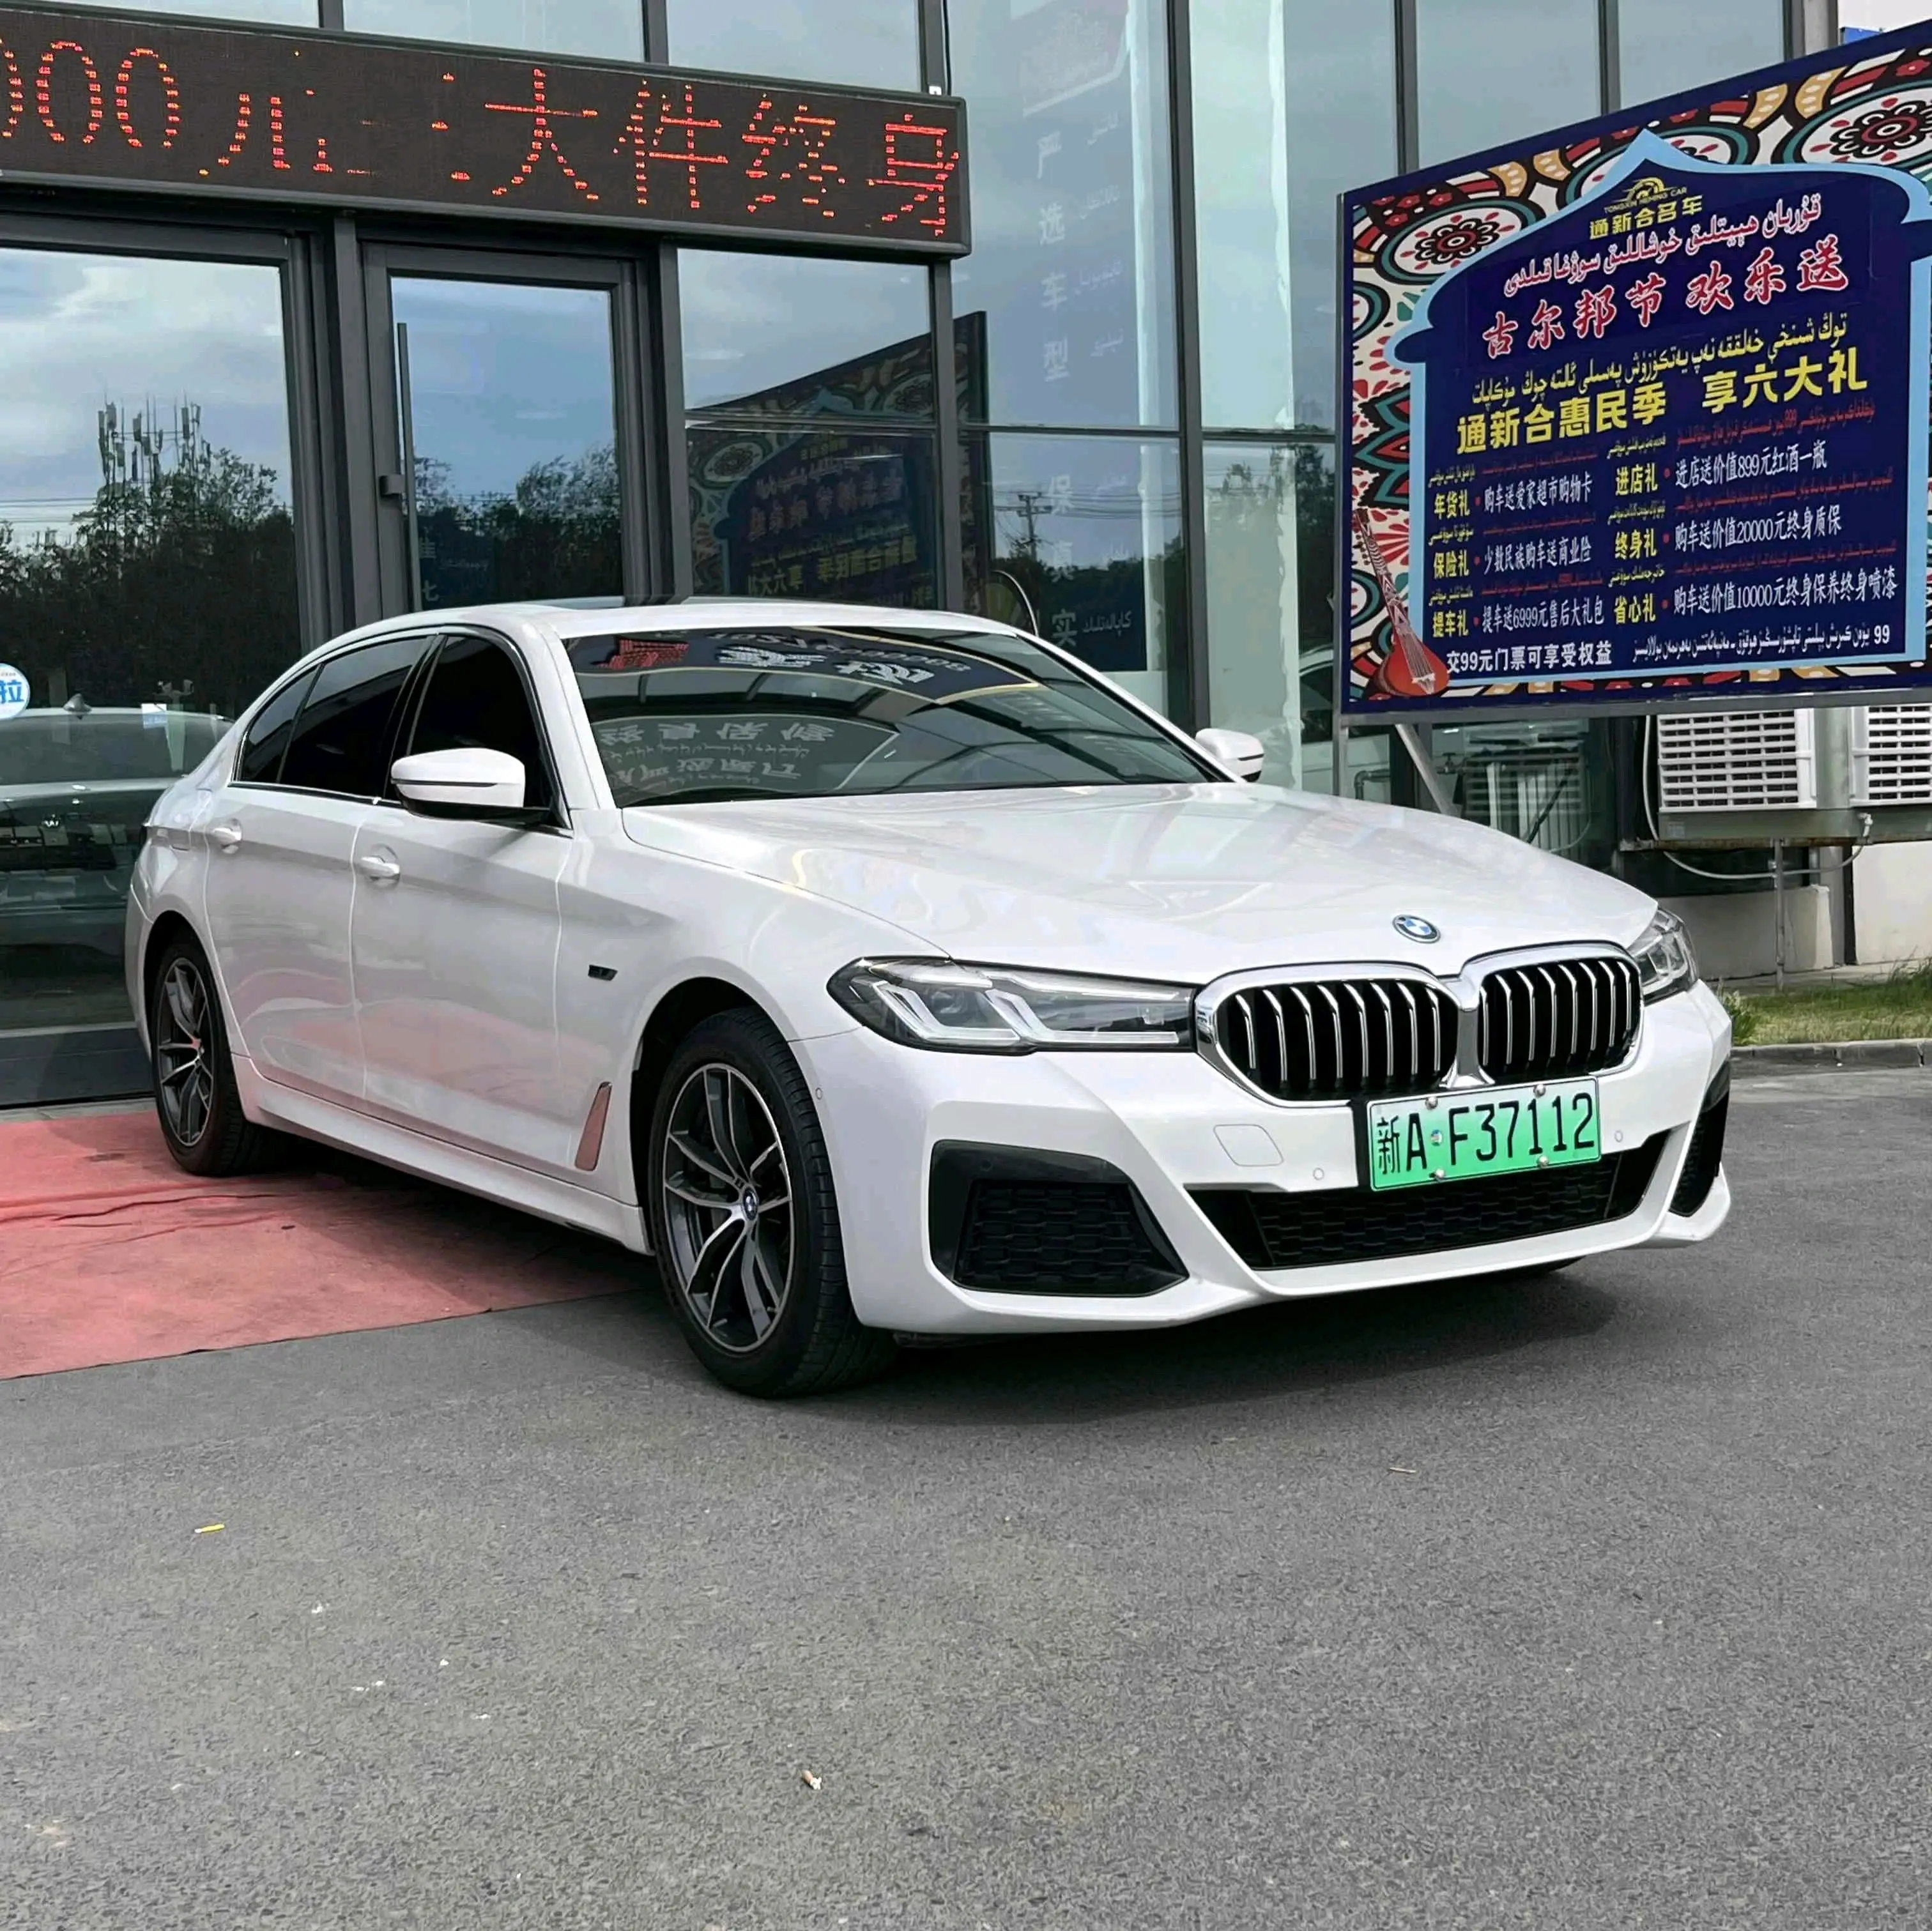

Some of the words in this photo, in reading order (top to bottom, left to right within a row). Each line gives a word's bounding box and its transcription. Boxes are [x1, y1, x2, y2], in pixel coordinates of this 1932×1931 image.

[1671, 187, 1687, 197] CAR
[1590, 195, 1702, 239] 通新合名车
[1482, 272, 1666, 359] 古尔邦节
[1685, 234, 1848, 315] 欢乐送
[1457, 381, 1666, 454] 通新合惠民季
[1702, 347, 1867, 413] 享六大礼
[1615, 462, 1658, 496] 进店礼
[1675, 439, 1828, 489] 进店送价值899元红酒一瓶
[1434, 490, 1470, 519] 年货礼
[1483, 471, 1593, 513] 购车送爱家超市购物卡
[1614, 528, 1658, 561] 终身礼
[1674, 504, 1842, 552] 购车送价值20000元终身质保
[1433, 549, 1469, 579] 保险礼
[1483, 535, 1592, 575] 少数民族购车送商业险
[1432, 609, 1469, 638] 提车礼
[1481, 594, 1606, 634] 提车送6999元售后大礼包
[1613, 593, 1656, 625] 省心礼
[1673, 565, 1897, 616] 购车送价值10000元终身保养终身喷漆
[1446, 640, 1613, 674] 交99元门票可享受权益
[1874, 625, 1890, 644] 99
